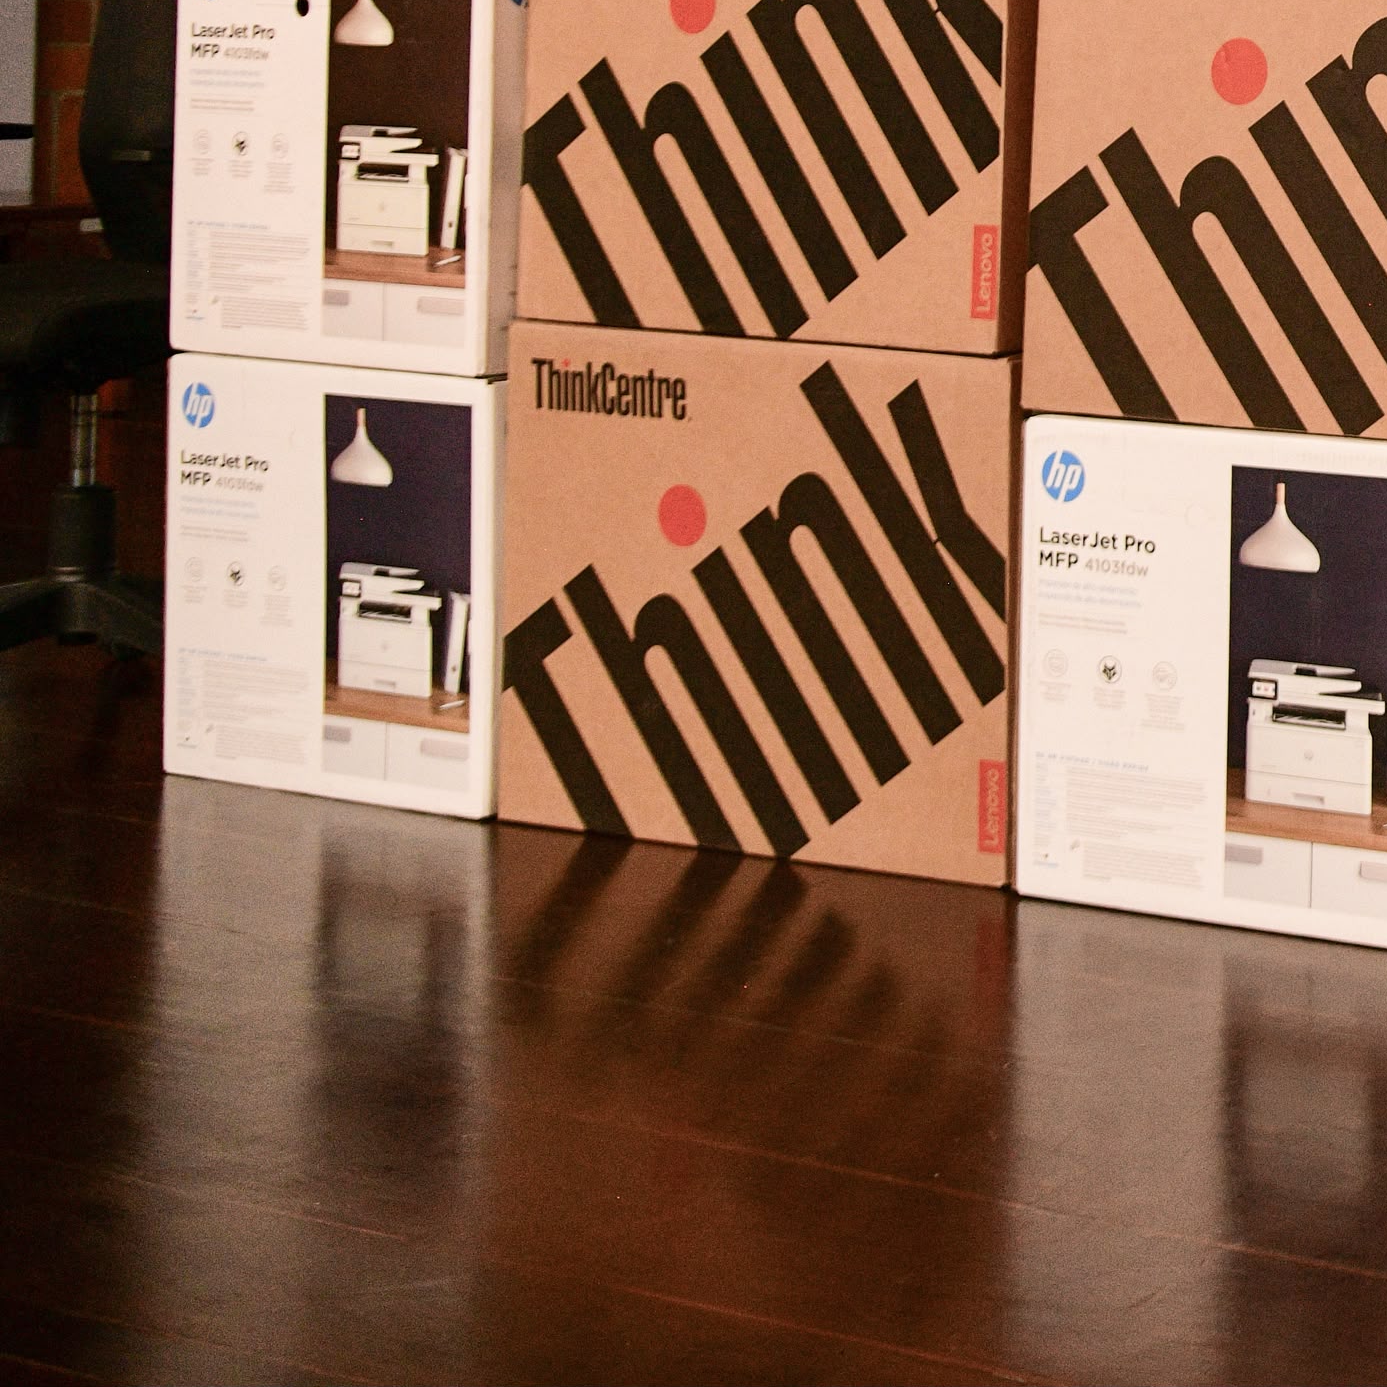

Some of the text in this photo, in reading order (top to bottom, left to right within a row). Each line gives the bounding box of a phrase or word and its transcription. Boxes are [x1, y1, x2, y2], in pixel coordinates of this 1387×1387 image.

[190, 22, 276, 40] LaserJet Pro
[190, 43, 220, 58] MFP
[976, 232, 993, 312] Lenovo
[531, 357, 688, 420] ThinkCentre
[182, 382, 215, 428] hp
[180, 450, 269, 472] LaserJet Pro
[180, 471, 211, 486] MFP
[1042, 450, 1085, 502] hp
[1039, 526, 1156, 554] LaserJet Pro
[1039, 550, 1149, 577] MFP 4103fdw
[504, 360, 1006, 858] Think
